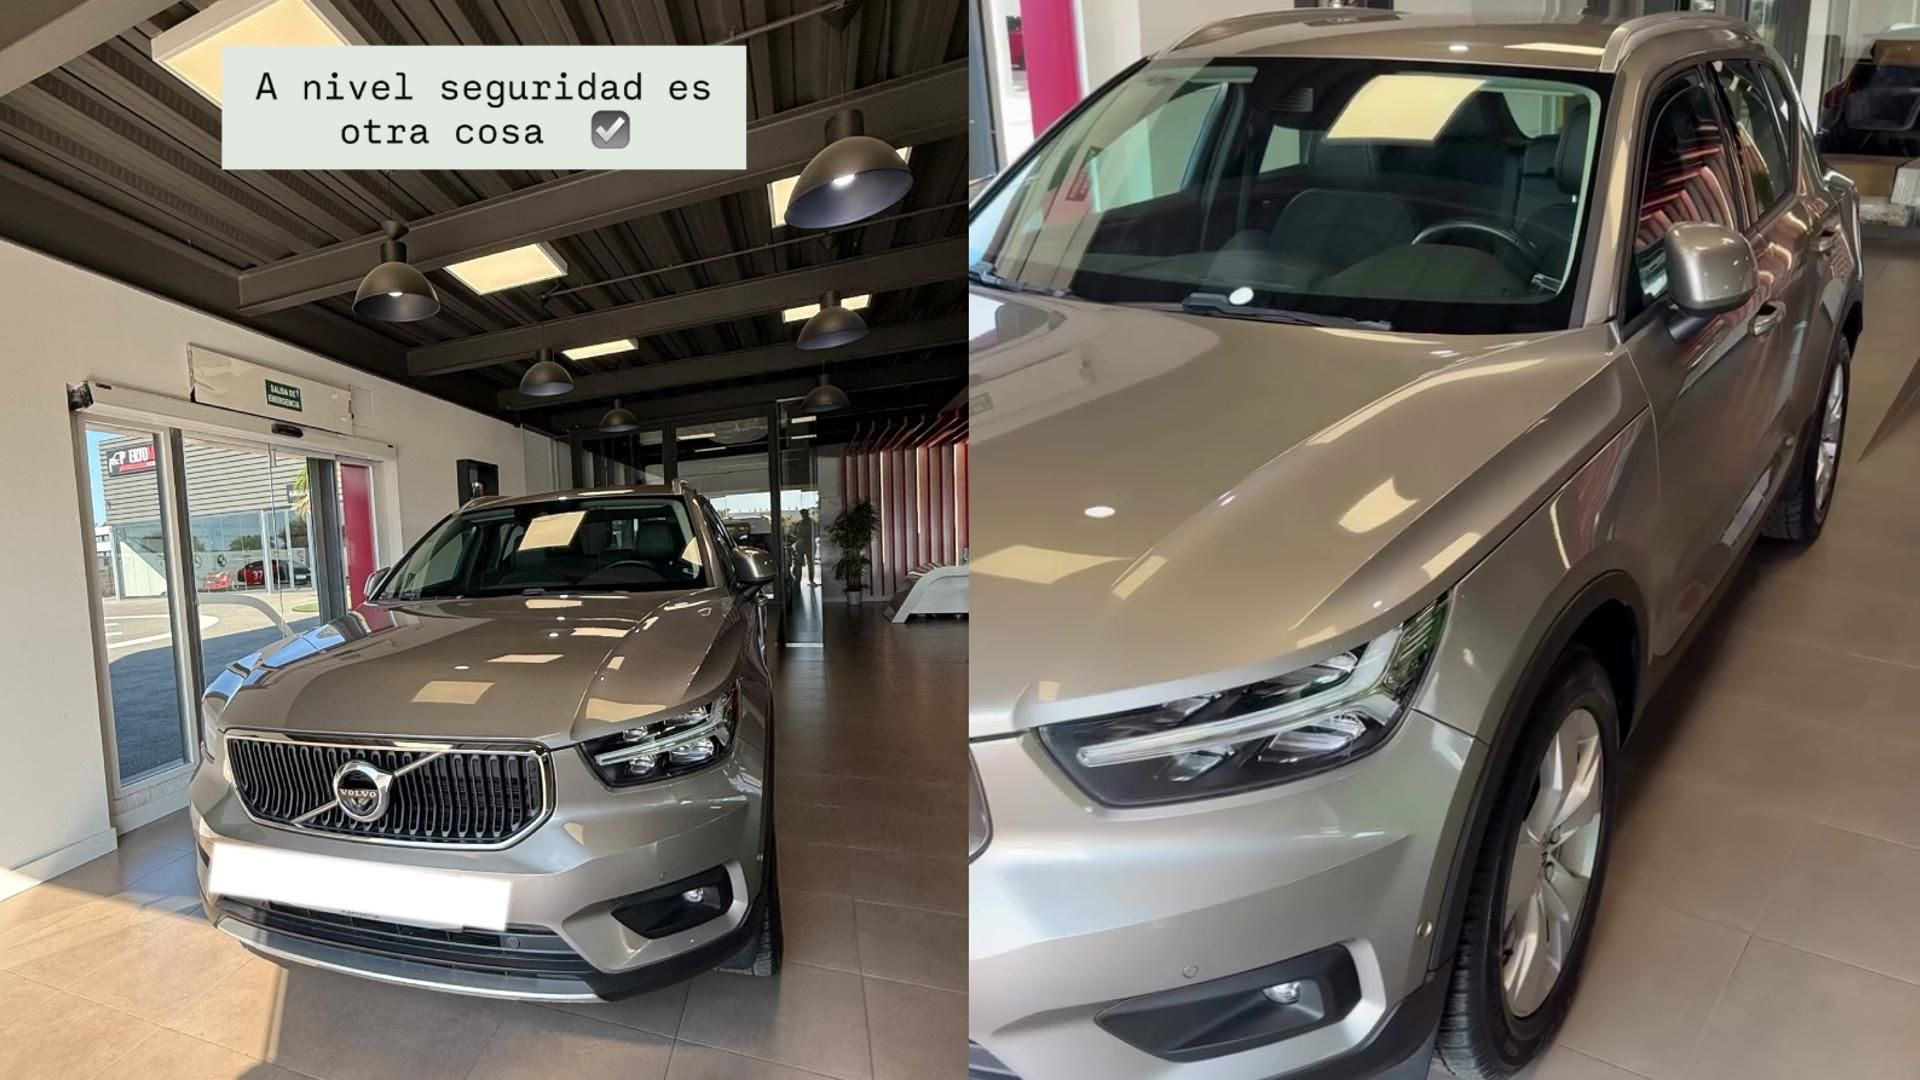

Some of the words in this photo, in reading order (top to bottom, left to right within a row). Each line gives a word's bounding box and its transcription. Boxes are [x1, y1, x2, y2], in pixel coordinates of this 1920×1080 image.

[270, 384, 288, 395] SALIDA
[268, 394, 300, 408] EMERGENCIA
[339, 788, 377, 798] VOLVO
